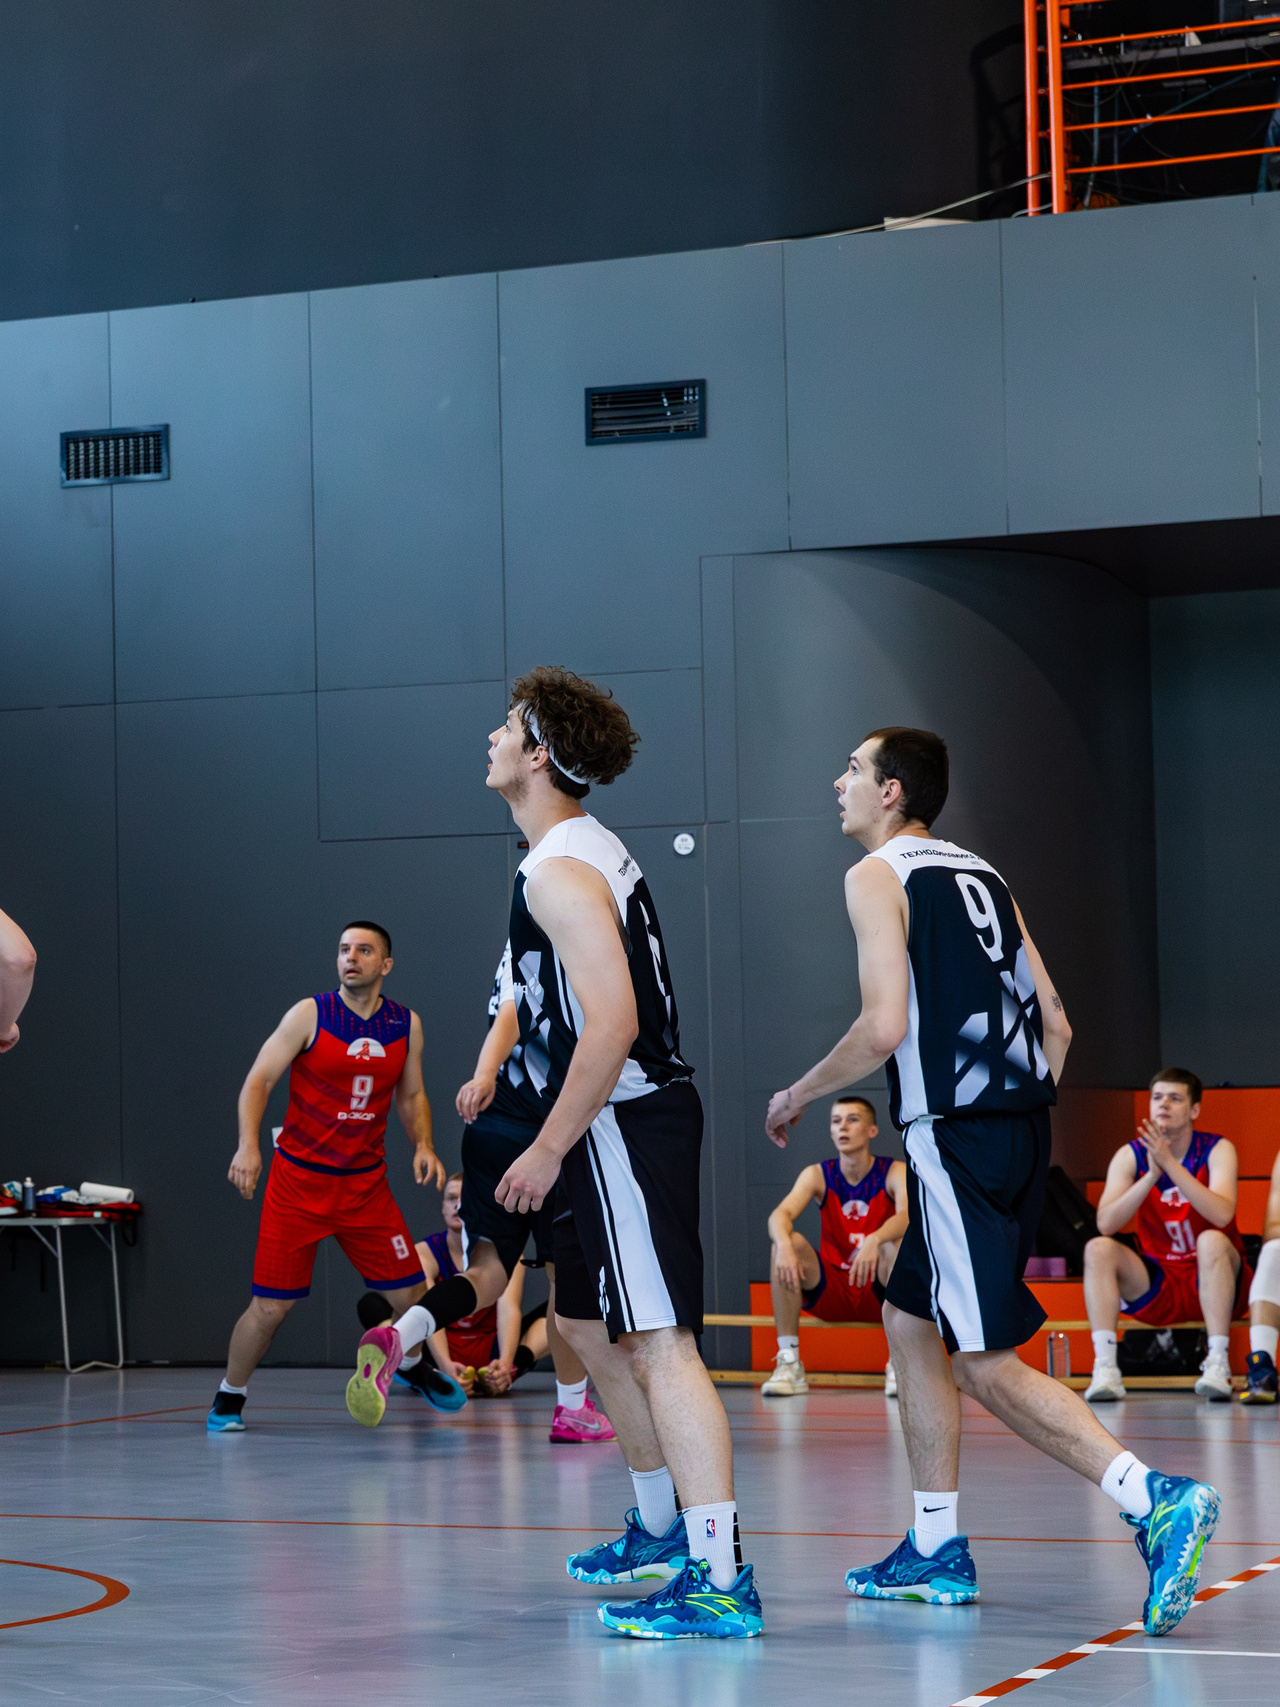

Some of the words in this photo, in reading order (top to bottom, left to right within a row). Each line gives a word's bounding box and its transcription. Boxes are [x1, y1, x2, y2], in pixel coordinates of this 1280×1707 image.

[954, 872, 1005, 963] 9
[350, 1075, 374, 1111] 9
[391, 1234, 410, 1260] 9
[1164, 1219, 1196, 1253] 91
